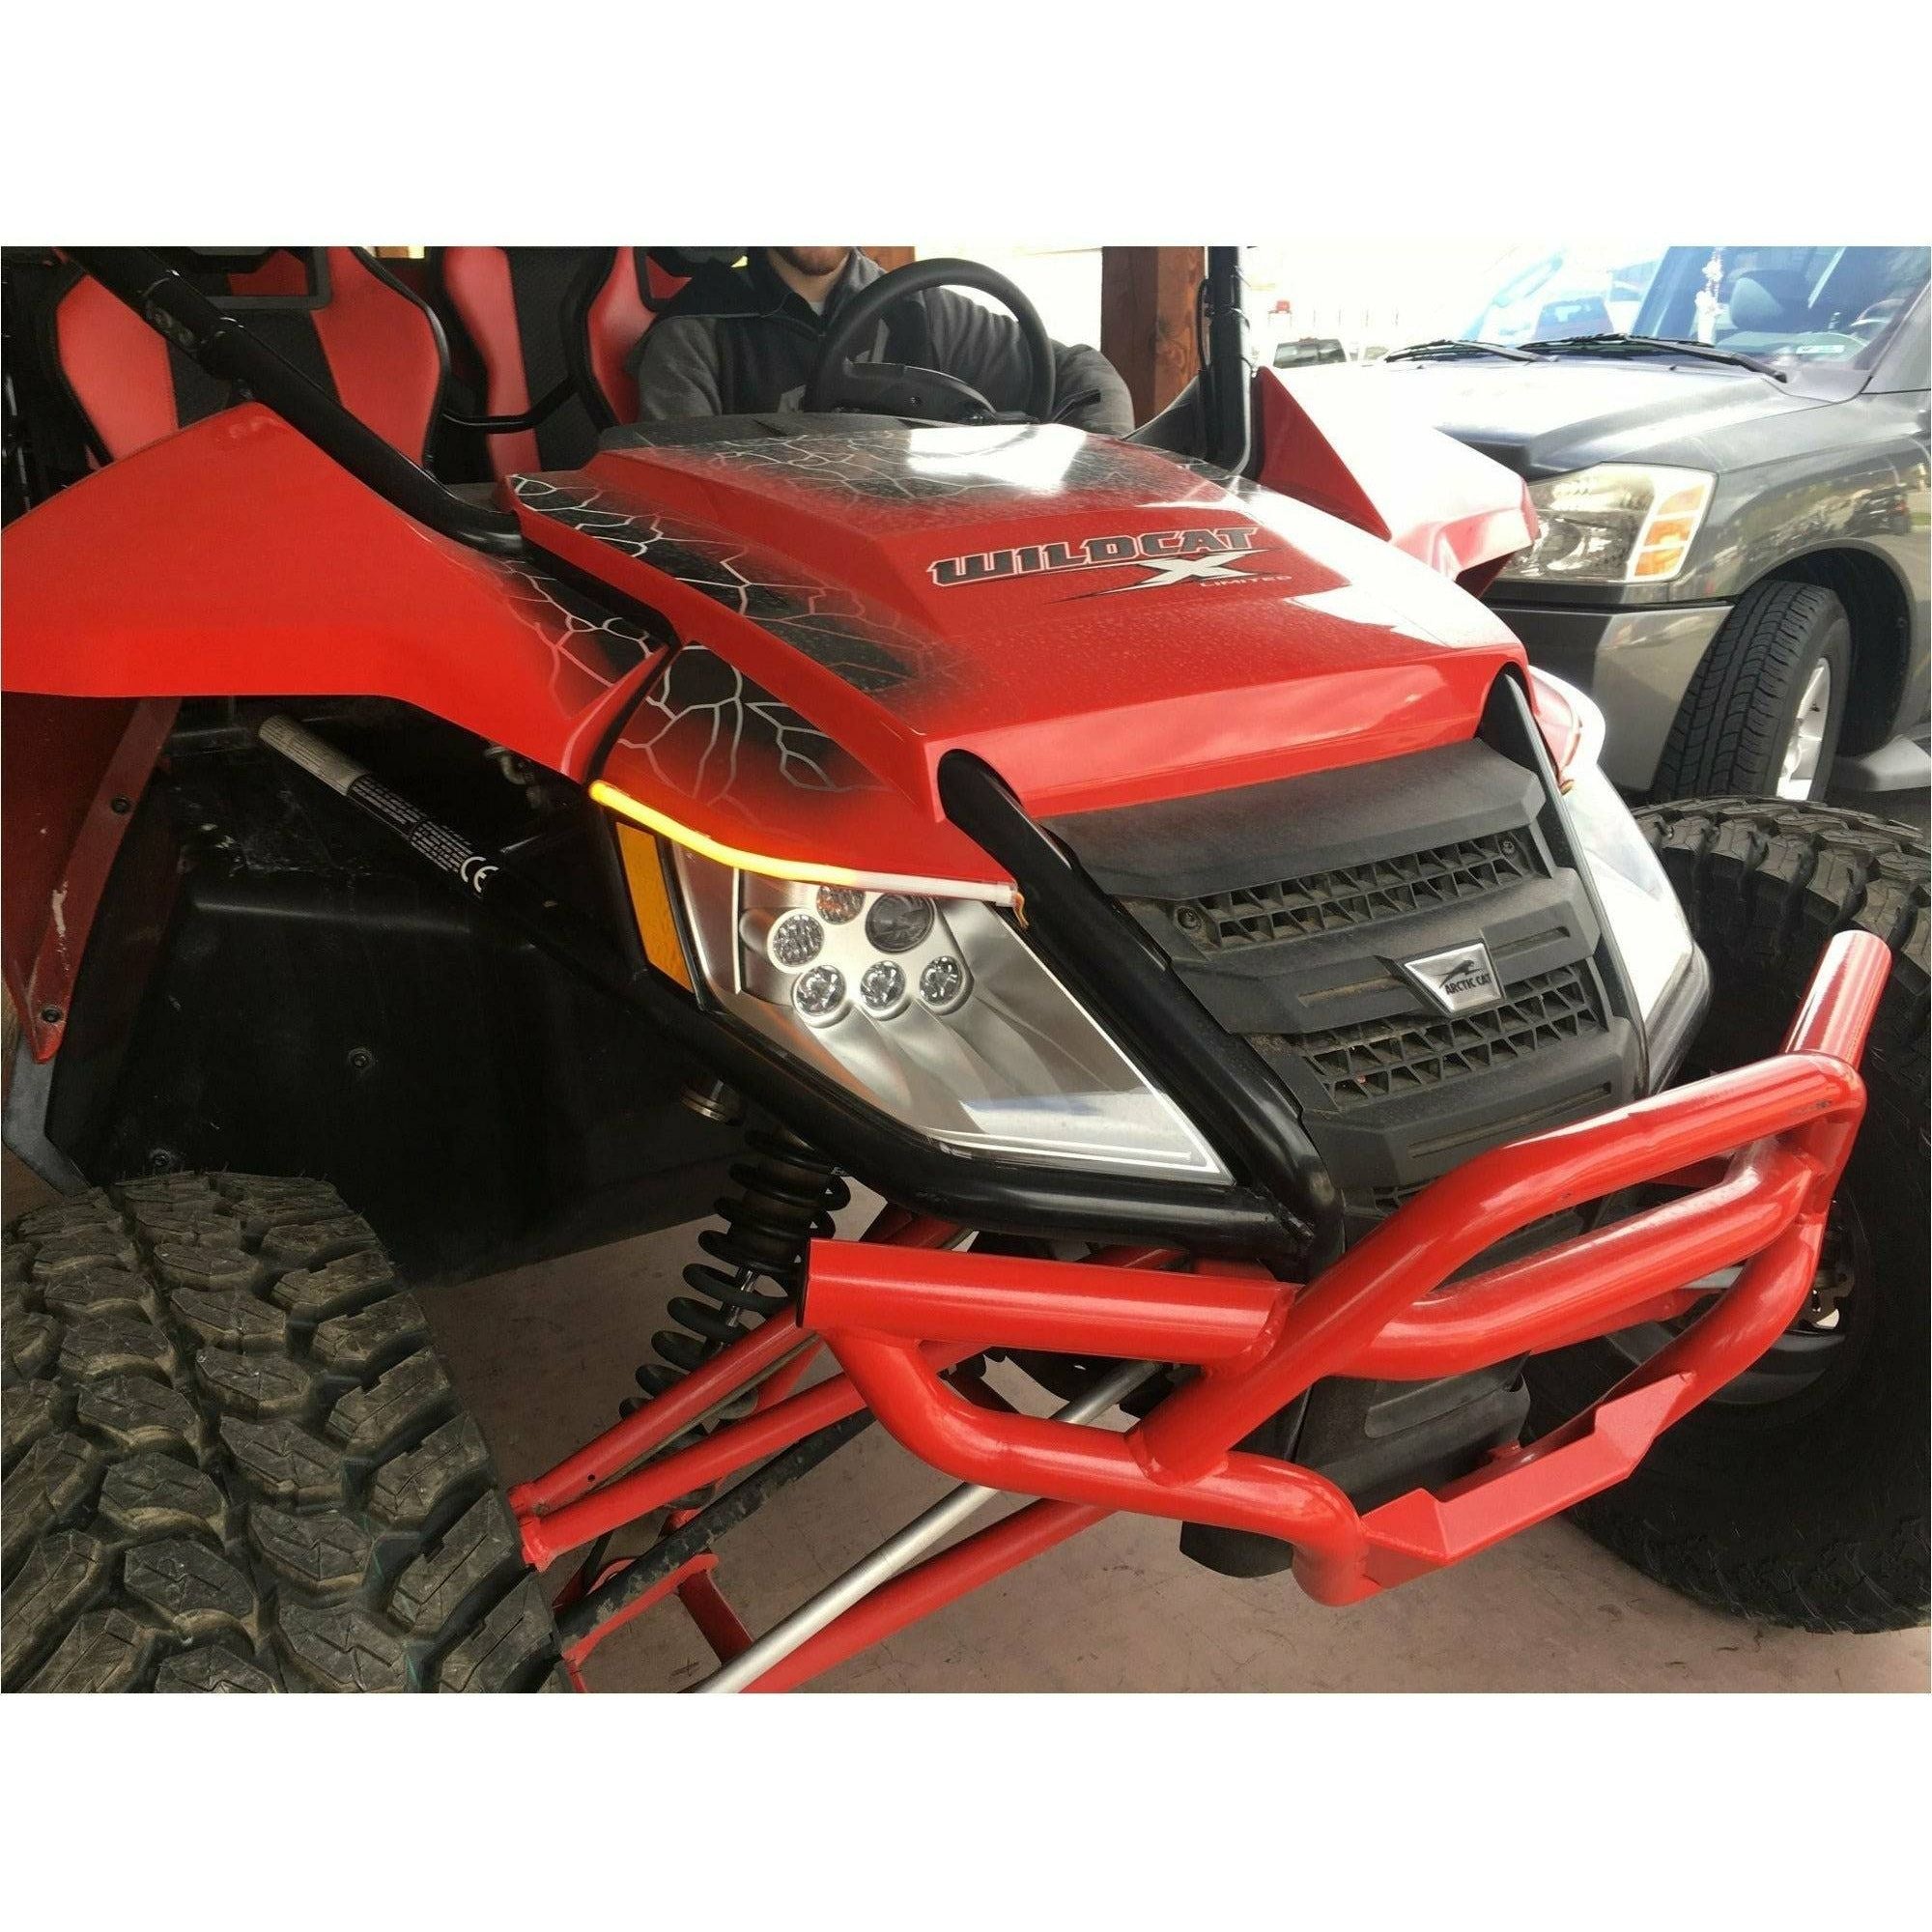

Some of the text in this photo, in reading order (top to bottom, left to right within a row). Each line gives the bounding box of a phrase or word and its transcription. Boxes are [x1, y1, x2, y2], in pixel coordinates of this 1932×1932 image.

[927, 527, 1259, 586] WILDCAT
[1199, 575, 1293, 587] LIMITED
[1444, 973, 1492, 995] ARCTIC CAT
